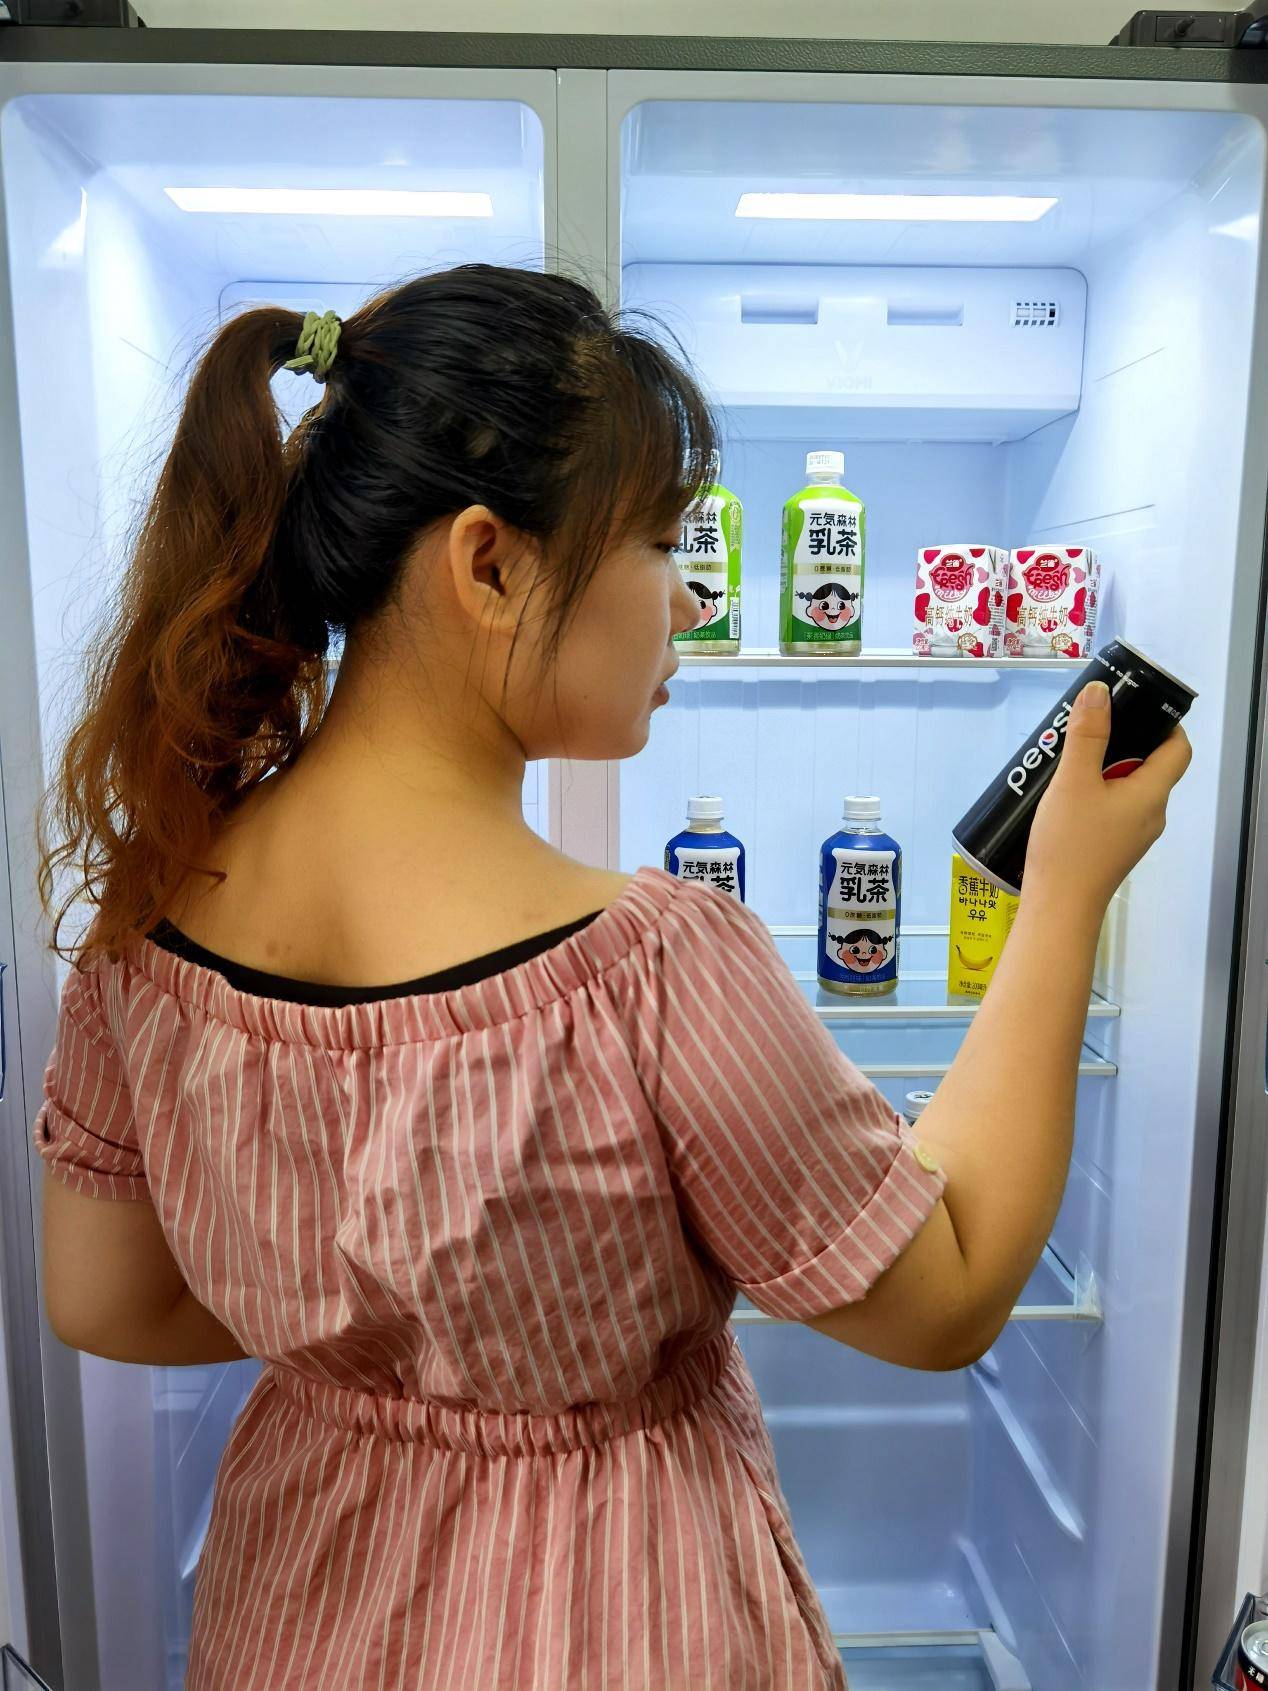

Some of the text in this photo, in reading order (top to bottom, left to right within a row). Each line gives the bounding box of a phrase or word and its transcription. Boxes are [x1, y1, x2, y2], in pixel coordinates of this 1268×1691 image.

[809, 512, 857, 528] 元気森林
[808, 527, 858, 557] 乳茶
[1007, 702, 1073, 796] pepsi
[683, 861, 734, 875] 元気森林
[840, 861, 889, 877] 元気森林
[840, 876, 889, 903] 乳茶
[968, 908, 987, 922] 우유
